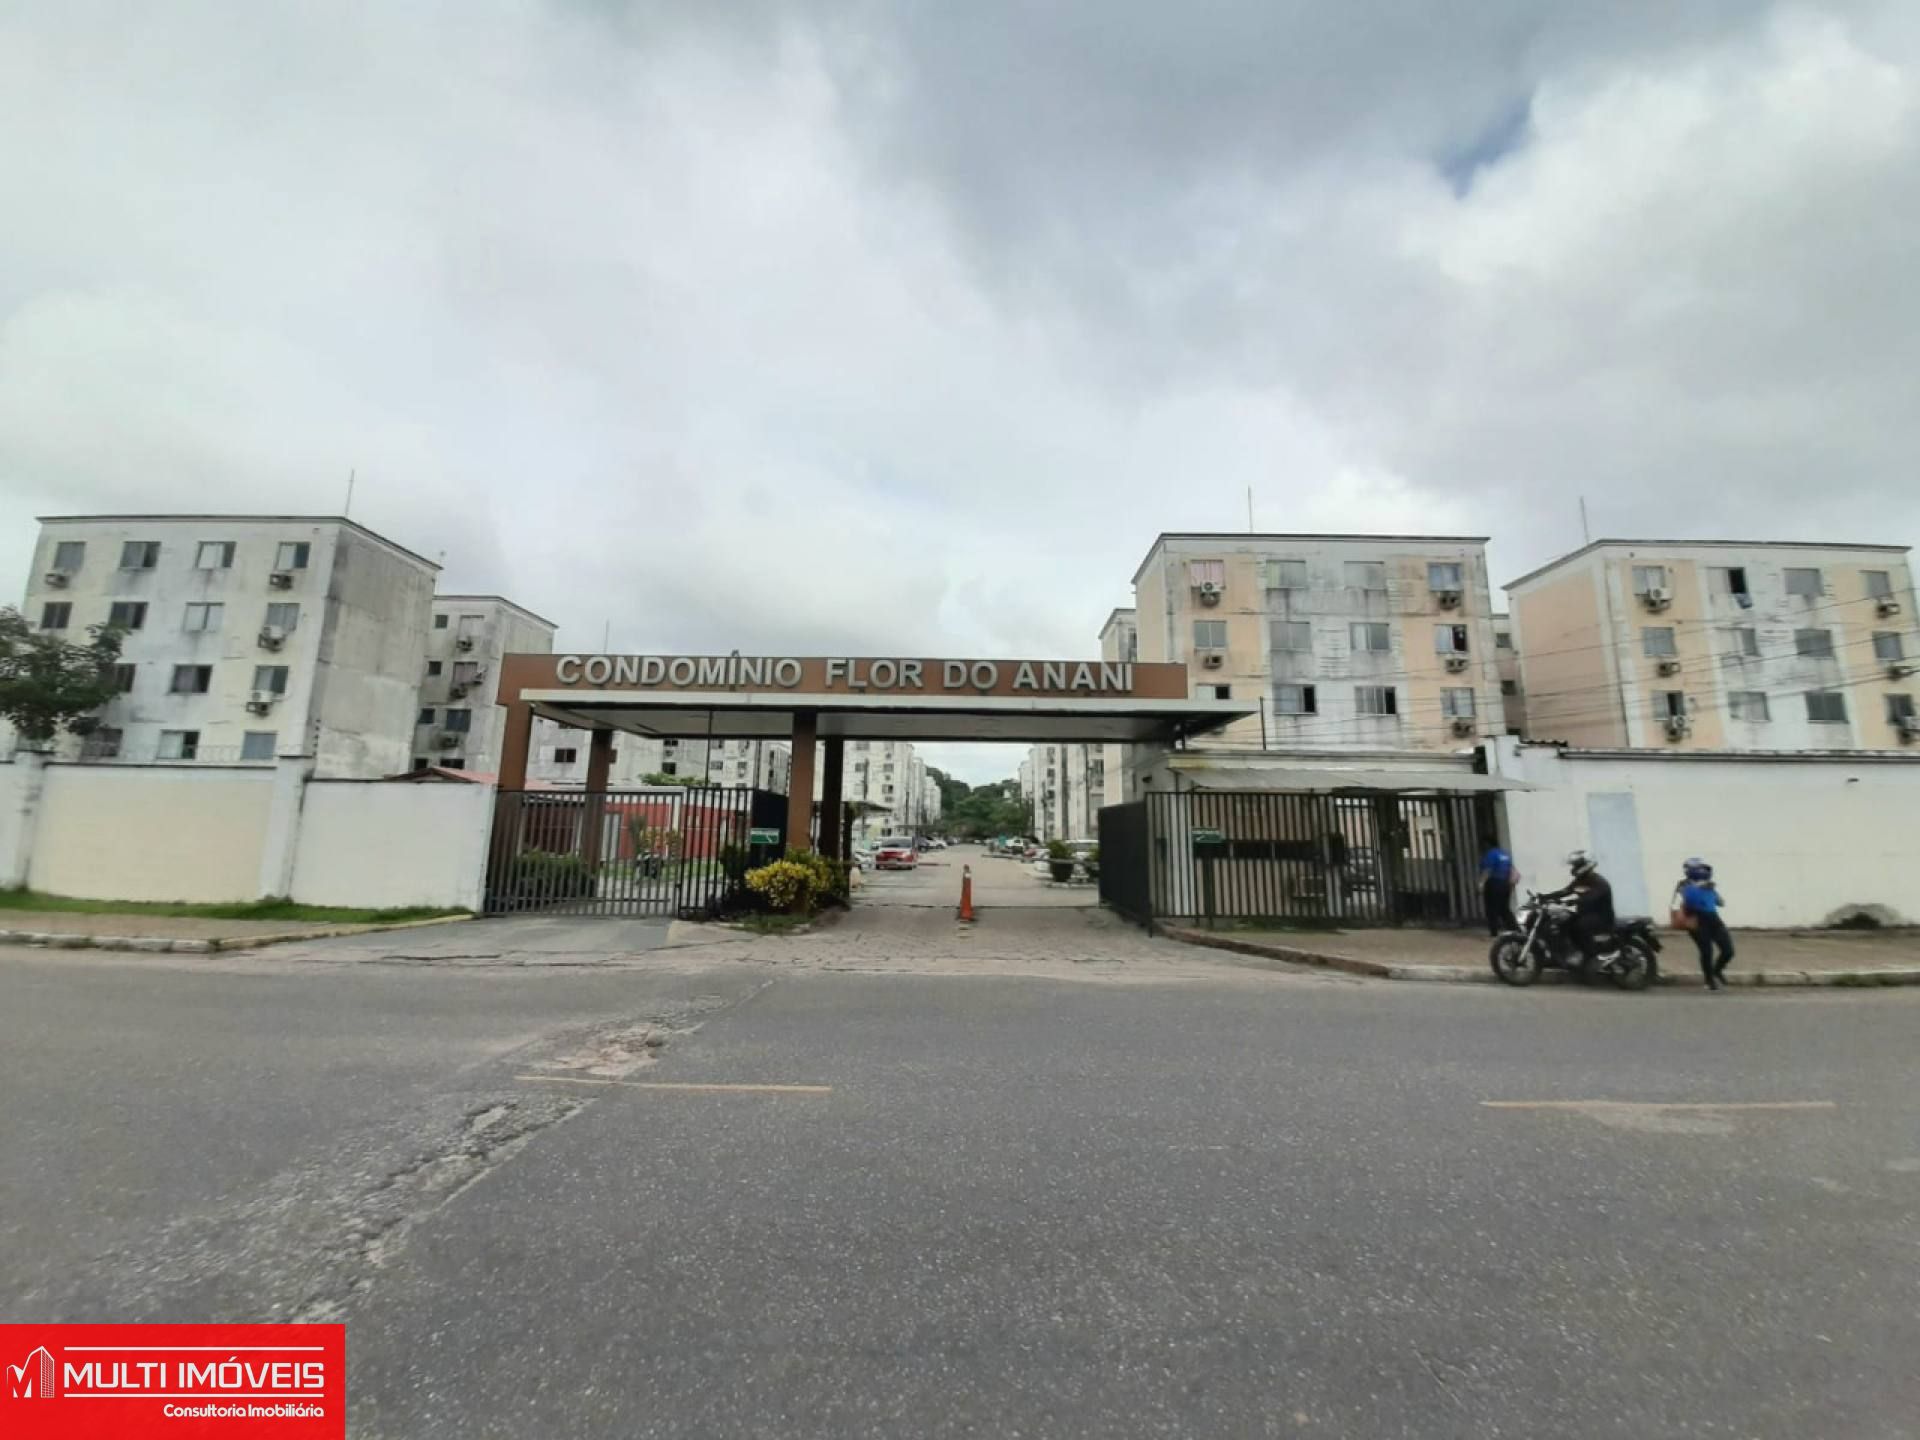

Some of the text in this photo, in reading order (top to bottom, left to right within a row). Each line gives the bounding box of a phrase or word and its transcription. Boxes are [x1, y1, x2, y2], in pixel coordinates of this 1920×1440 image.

[556, 650, 1133, 690] CONDOMÍNIO FLOR DO ANANI
